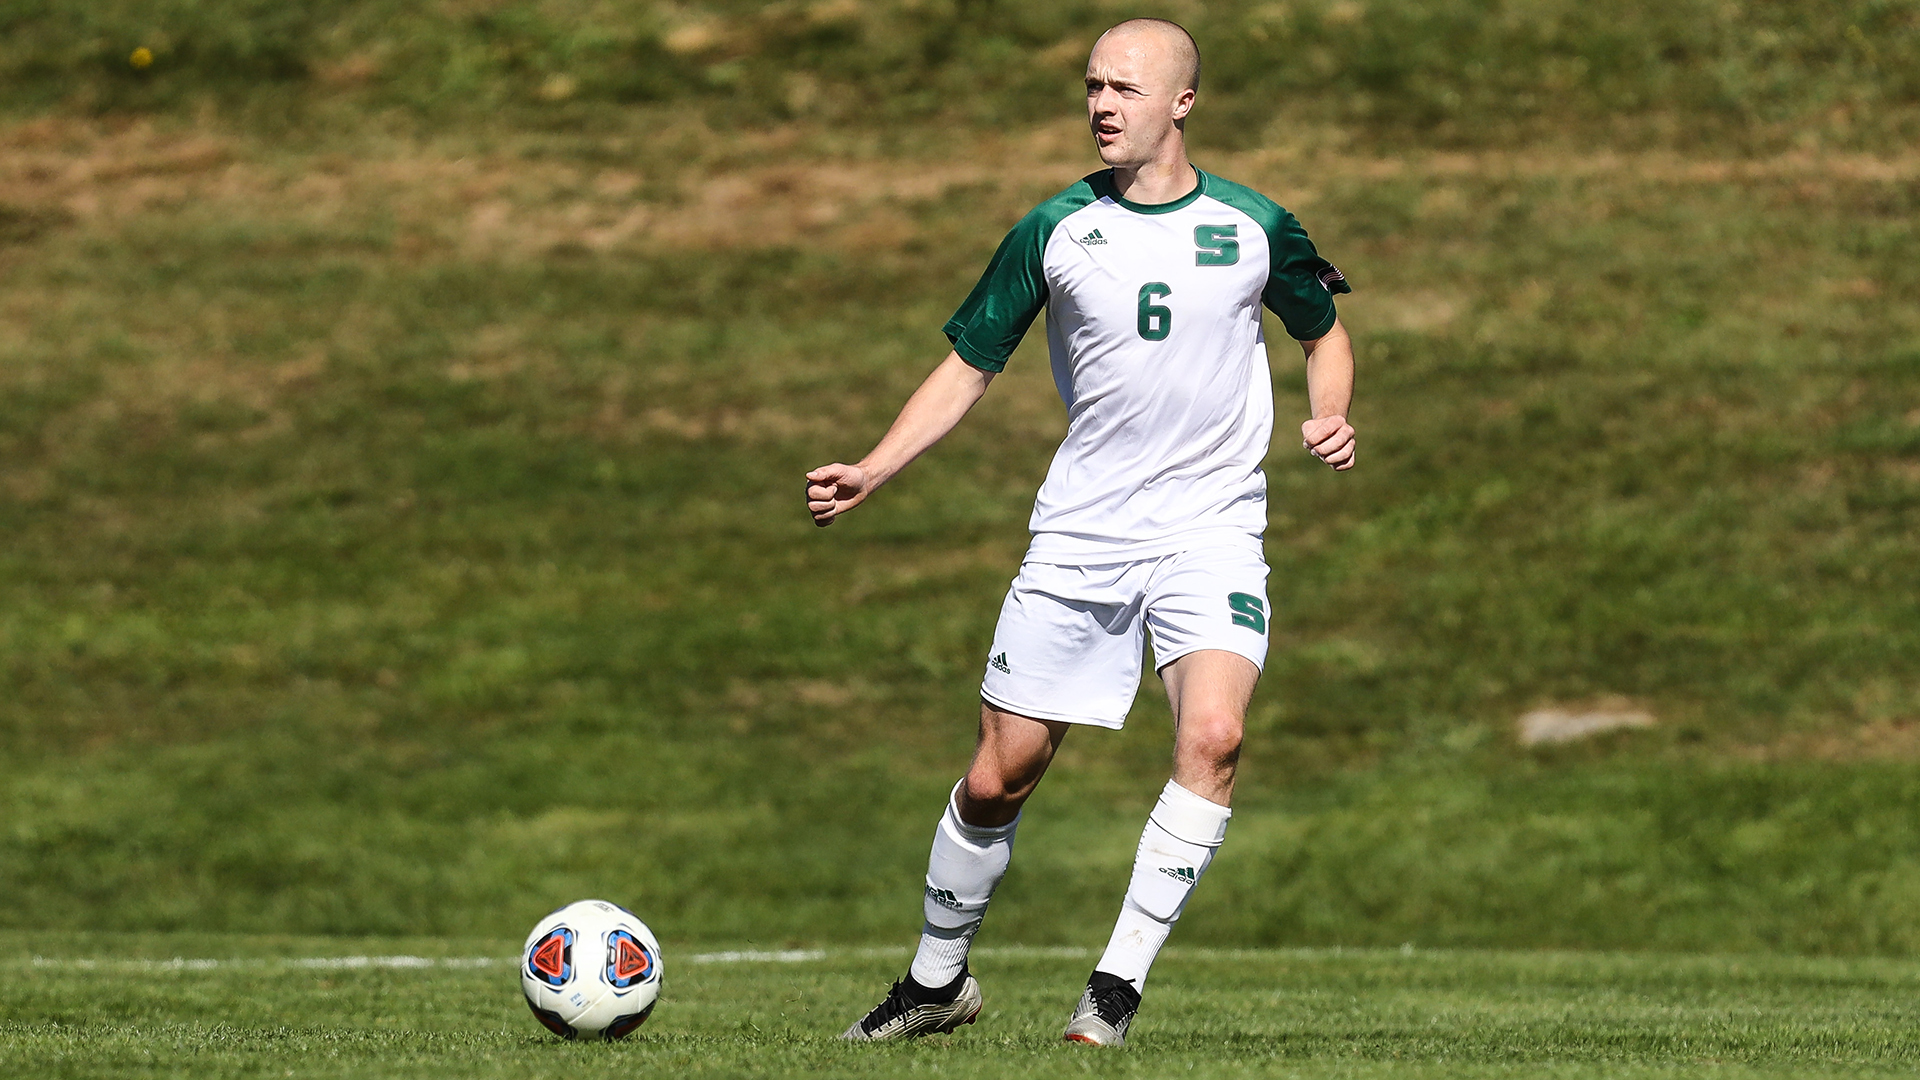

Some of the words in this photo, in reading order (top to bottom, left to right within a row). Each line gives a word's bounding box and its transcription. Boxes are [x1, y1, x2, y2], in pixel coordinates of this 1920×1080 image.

[1194, 224, 1240, 266] S
[1138, 282, 1172, 341] 6
[1228, 592, 1266, 636] S
